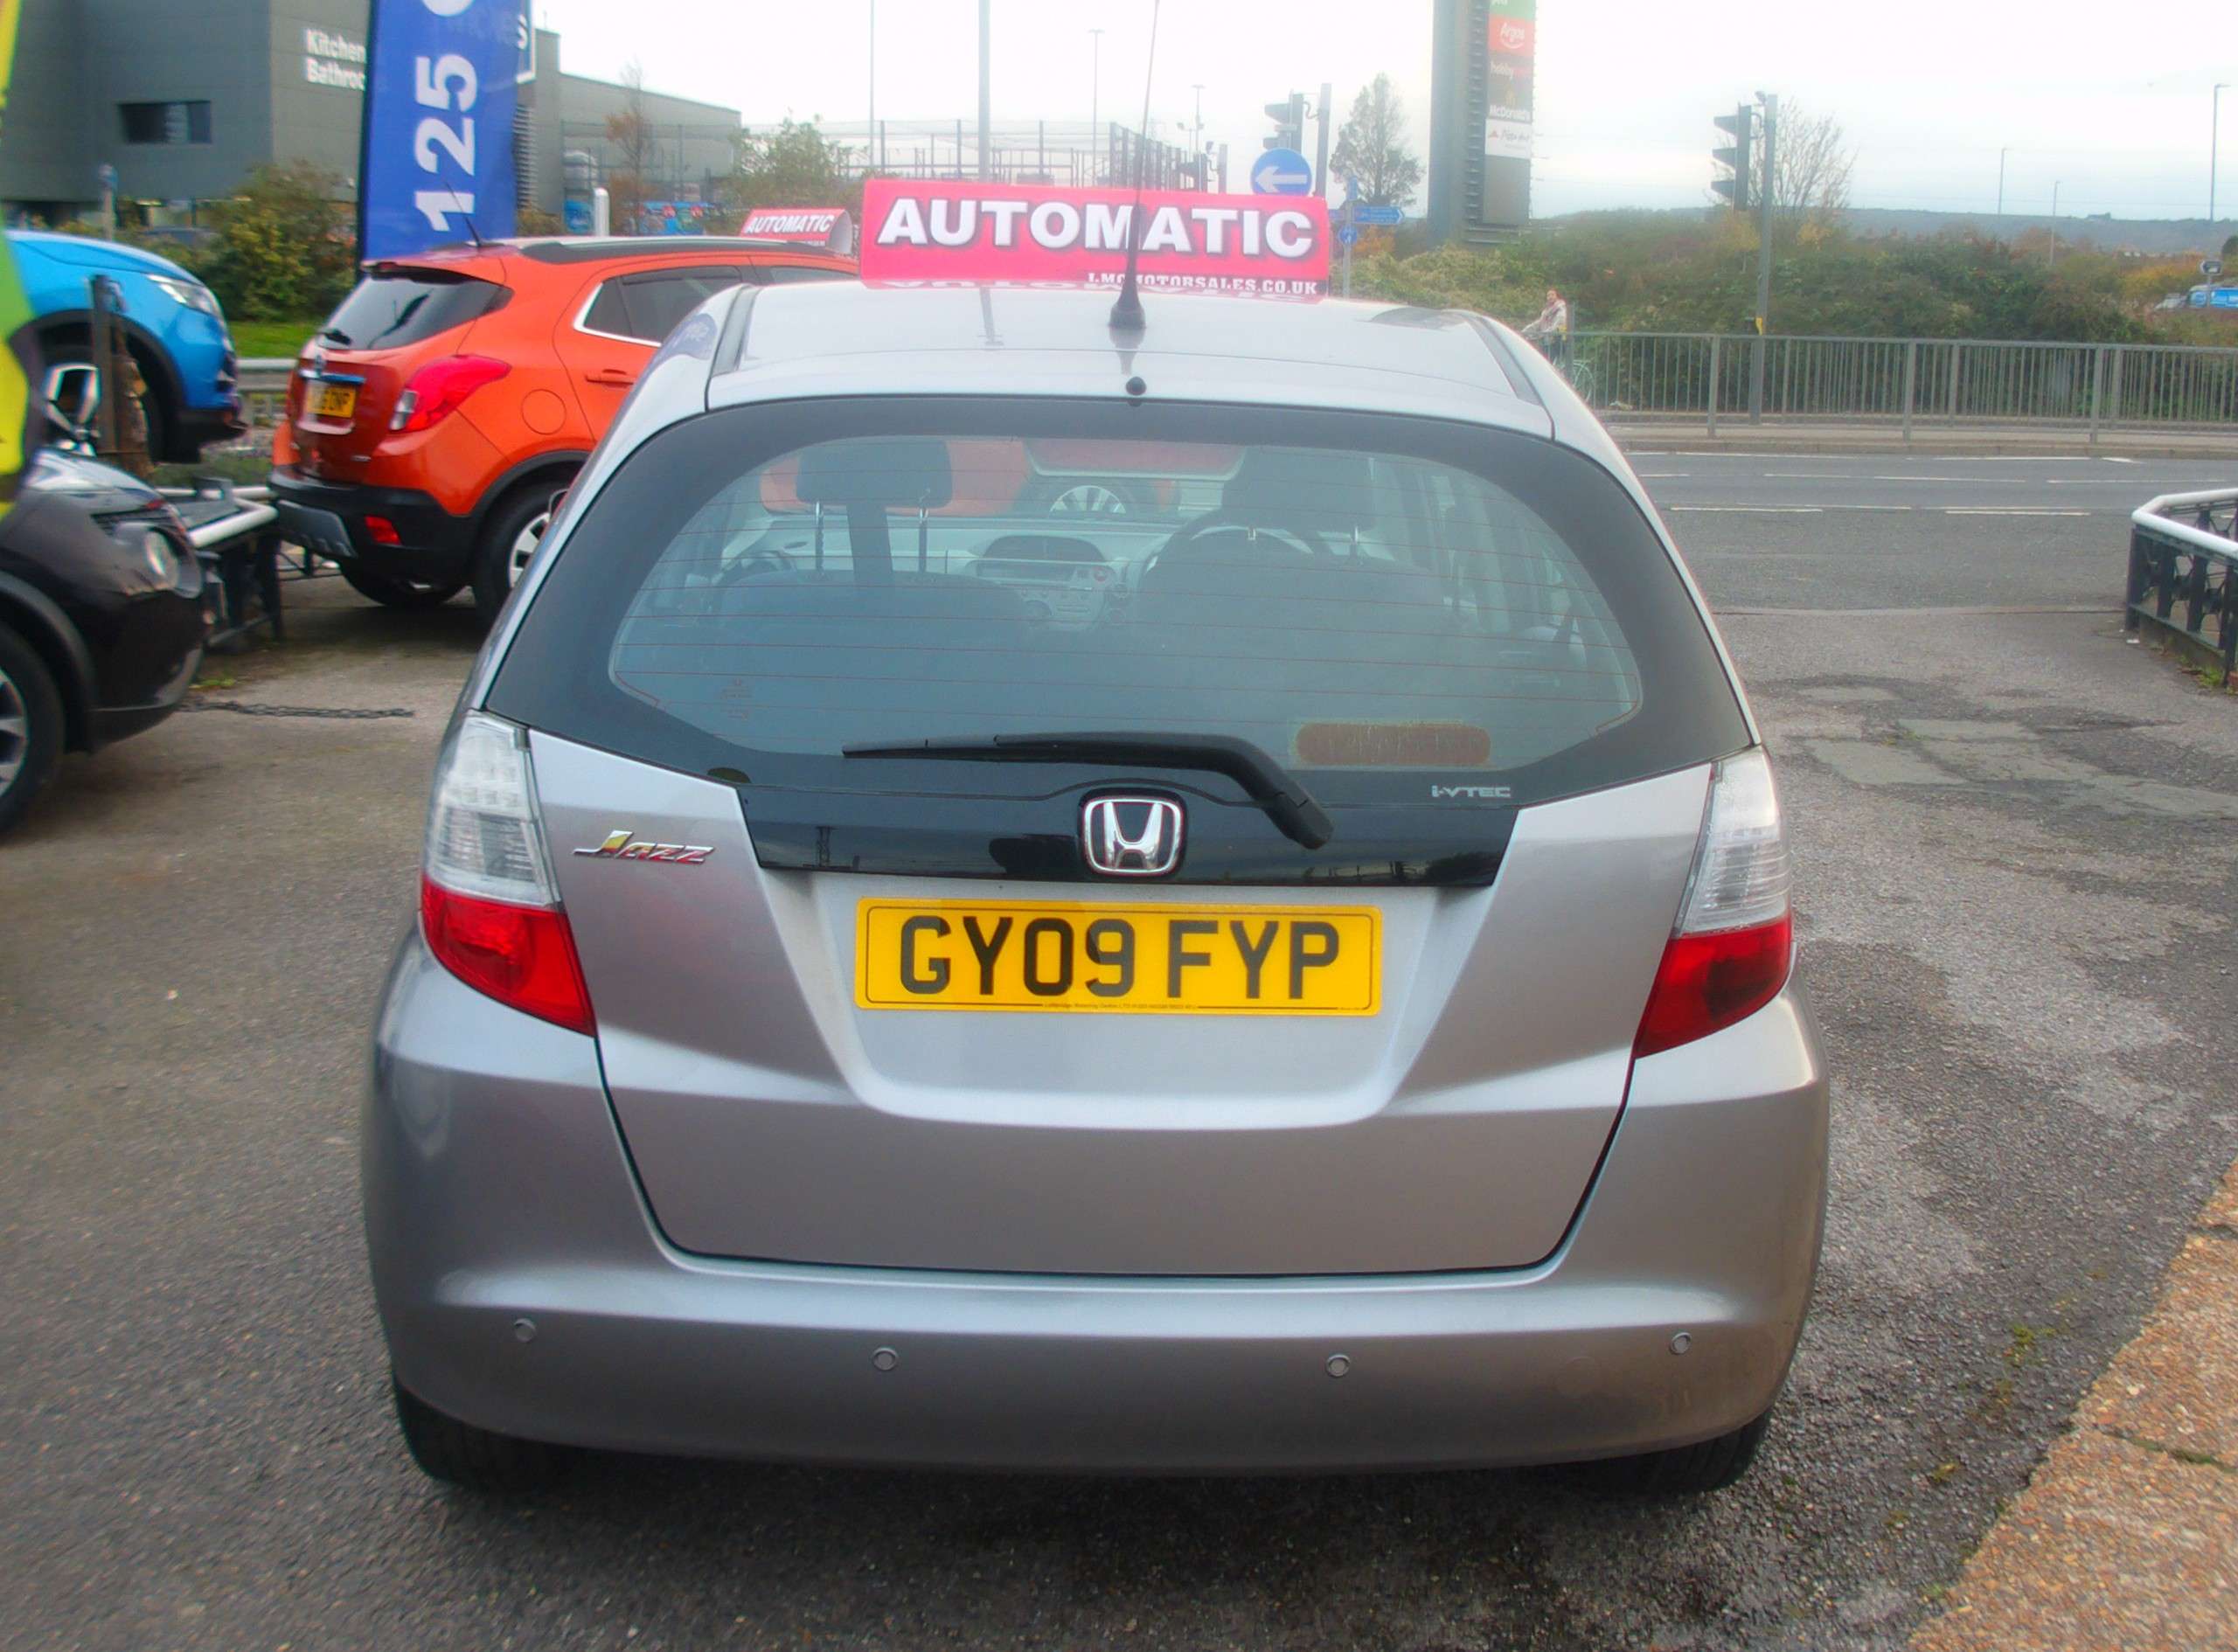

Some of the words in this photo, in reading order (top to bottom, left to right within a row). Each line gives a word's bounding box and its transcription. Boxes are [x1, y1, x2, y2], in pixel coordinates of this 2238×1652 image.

[307, 28, 366, 63] Kitchen
[414, 54, 477, 232] 125
[745, 214, 835, 233] AUTOMATIC
[877, 197, 1312, 259] AUTOMATIC
[573, 829, 715, 864] Jazz
[900, 914, 1135, 998] GY09
[1167, 920, 1339, 1000] FYP
